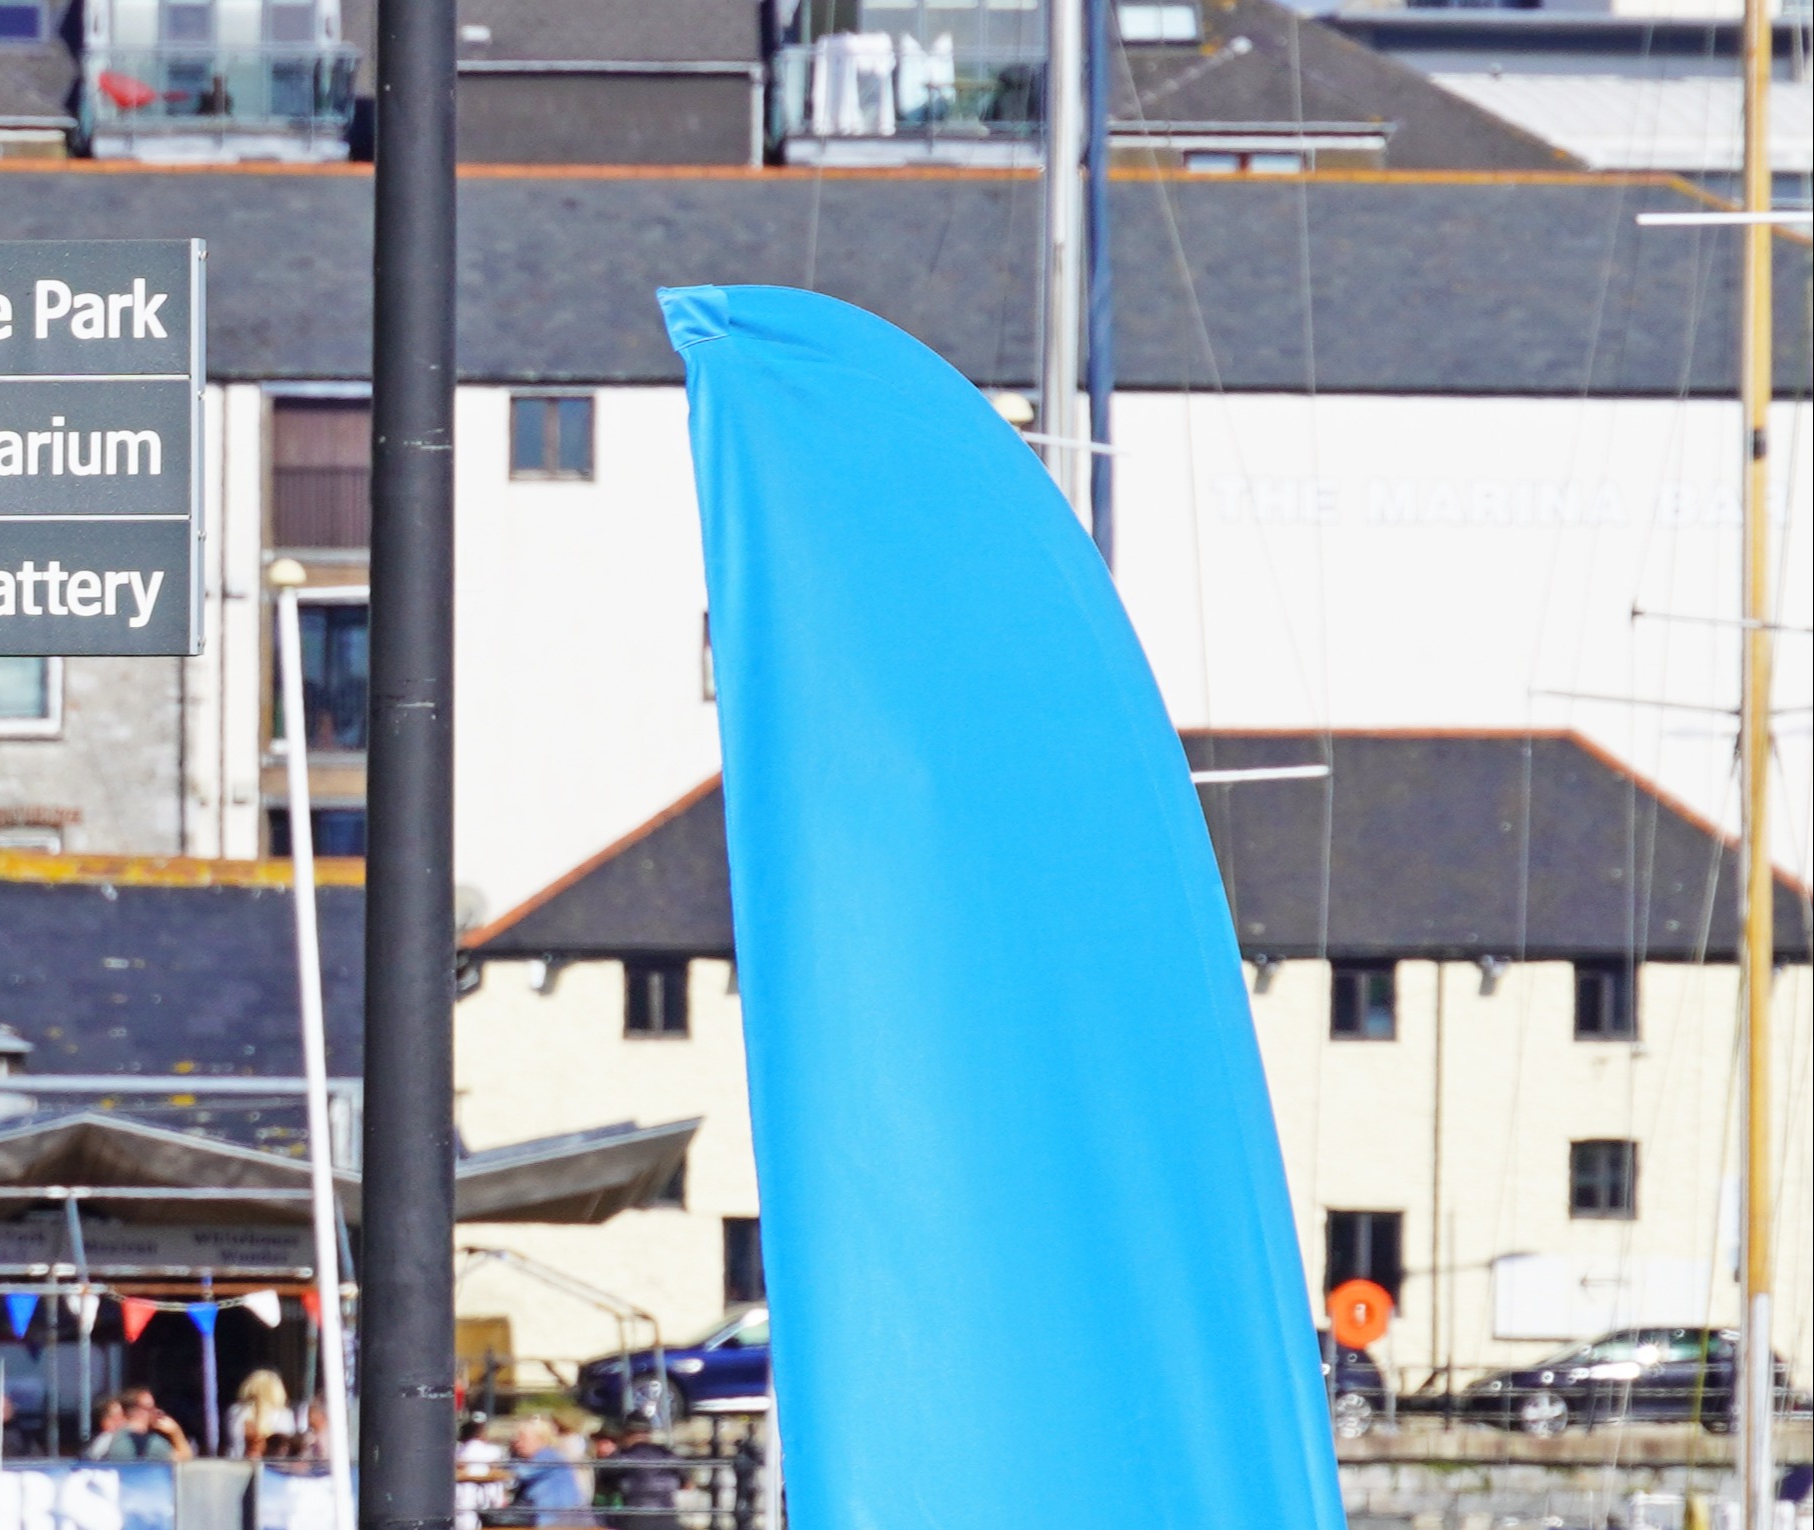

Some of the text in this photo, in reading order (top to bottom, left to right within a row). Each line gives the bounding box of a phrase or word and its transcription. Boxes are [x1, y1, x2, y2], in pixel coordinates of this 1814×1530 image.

[34, 279, 168, 339] Park
[1211, 476, 1339, 525] THE
[1364, 476, 1627, 526] MARINA
